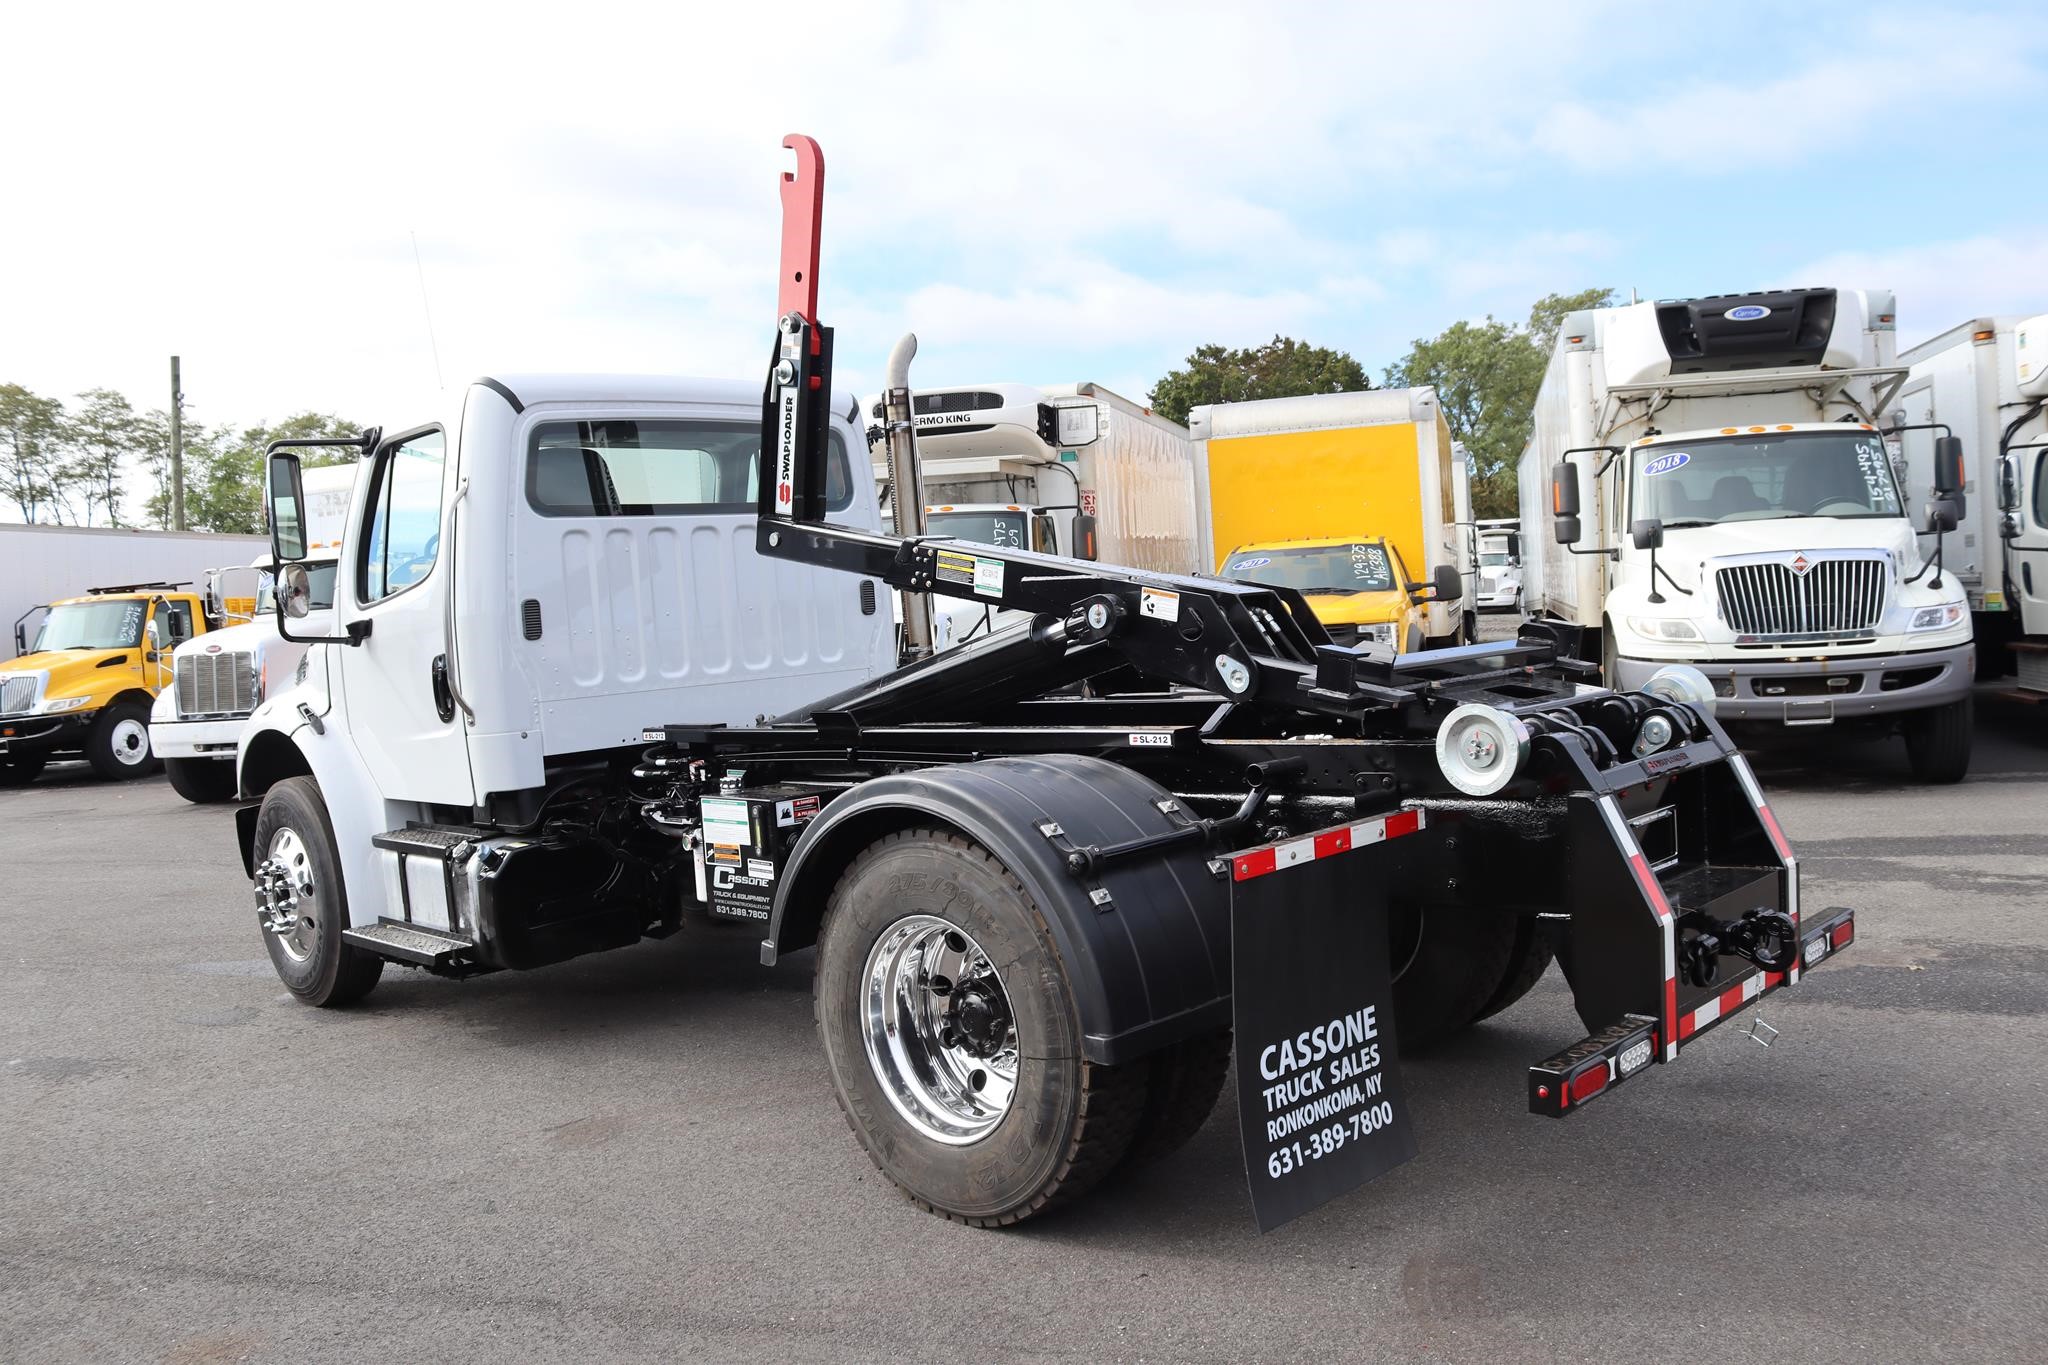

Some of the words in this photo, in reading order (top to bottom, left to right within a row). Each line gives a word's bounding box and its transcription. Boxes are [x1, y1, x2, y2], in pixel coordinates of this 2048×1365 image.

[781, 396, 794, 481] SWAPLOADER
[914, 416, 944, 426] ERMO
[946, 414, 971, 424] KING
[1650, 454, 1681, 474] 2018
[1139, 735, 1168, 744] SL-212
[713, 890, 732, 898] TRUCK
[737, 893, 770, 903] EQUIPMENT
[716, 905, 768, 920] 631.389.7800
[1260, 1005, 1378, 1081] CASSONE
[1263, 1067, 1325, 1112] TRUCK
[1330, 1043, 1381, 1085] SALES
[1267, 1083, 1365, 1142] RONKONKOMA,
[1365, 1073, 1382, 1098] NY
[1268, 1101, 1393, 1179] 631-389-7800
